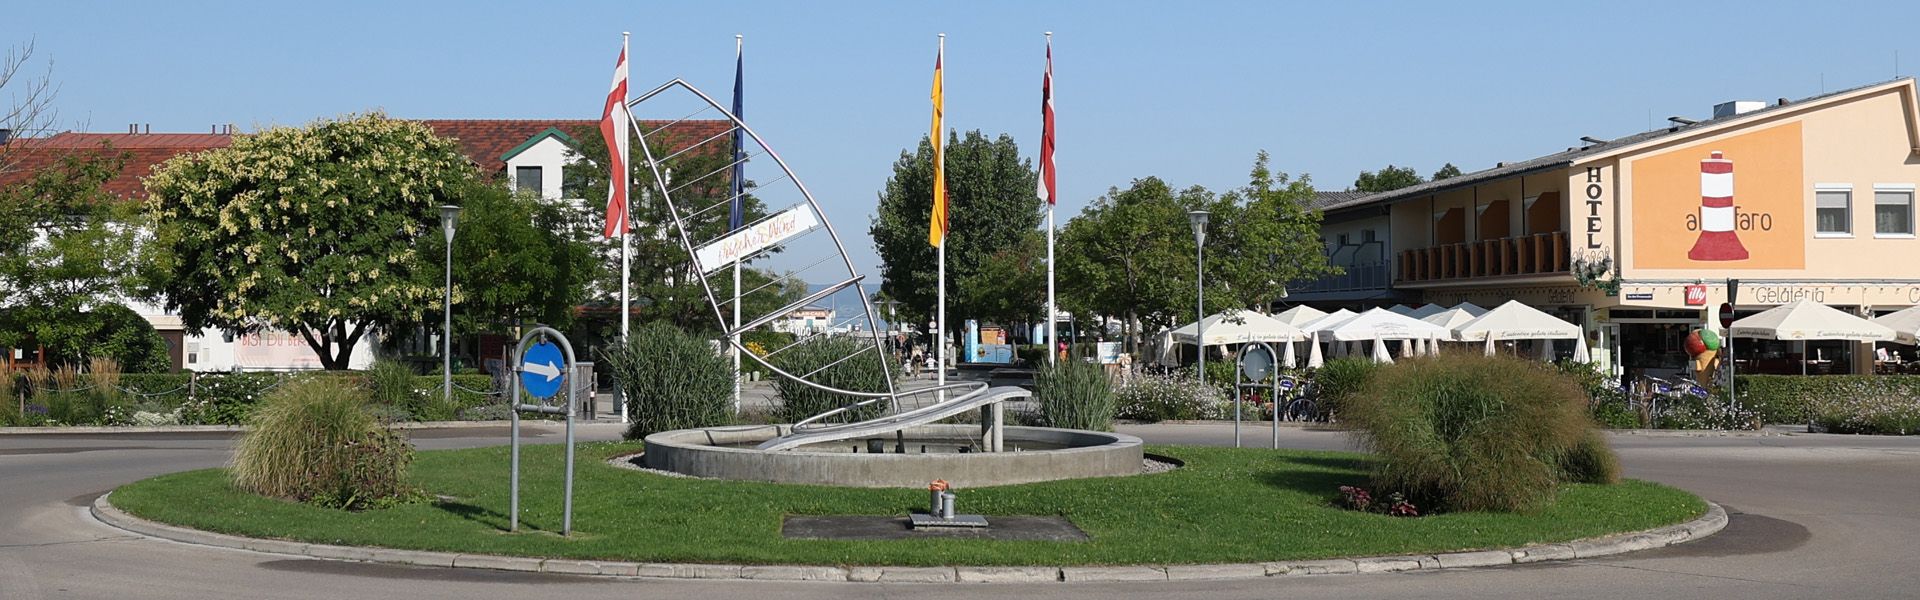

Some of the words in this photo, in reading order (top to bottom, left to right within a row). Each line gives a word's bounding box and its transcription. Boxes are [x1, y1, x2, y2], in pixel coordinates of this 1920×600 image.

[1586, 167, 1602, 249] HOTEL
[1686, 206, 1702, 231] al
[1734, 206, 1772, 231] faro
[1688, 287, 1706, 302] illy
[1755, 286, 1825, 303] Gelateria
[267, 333, 283, 346] DU
